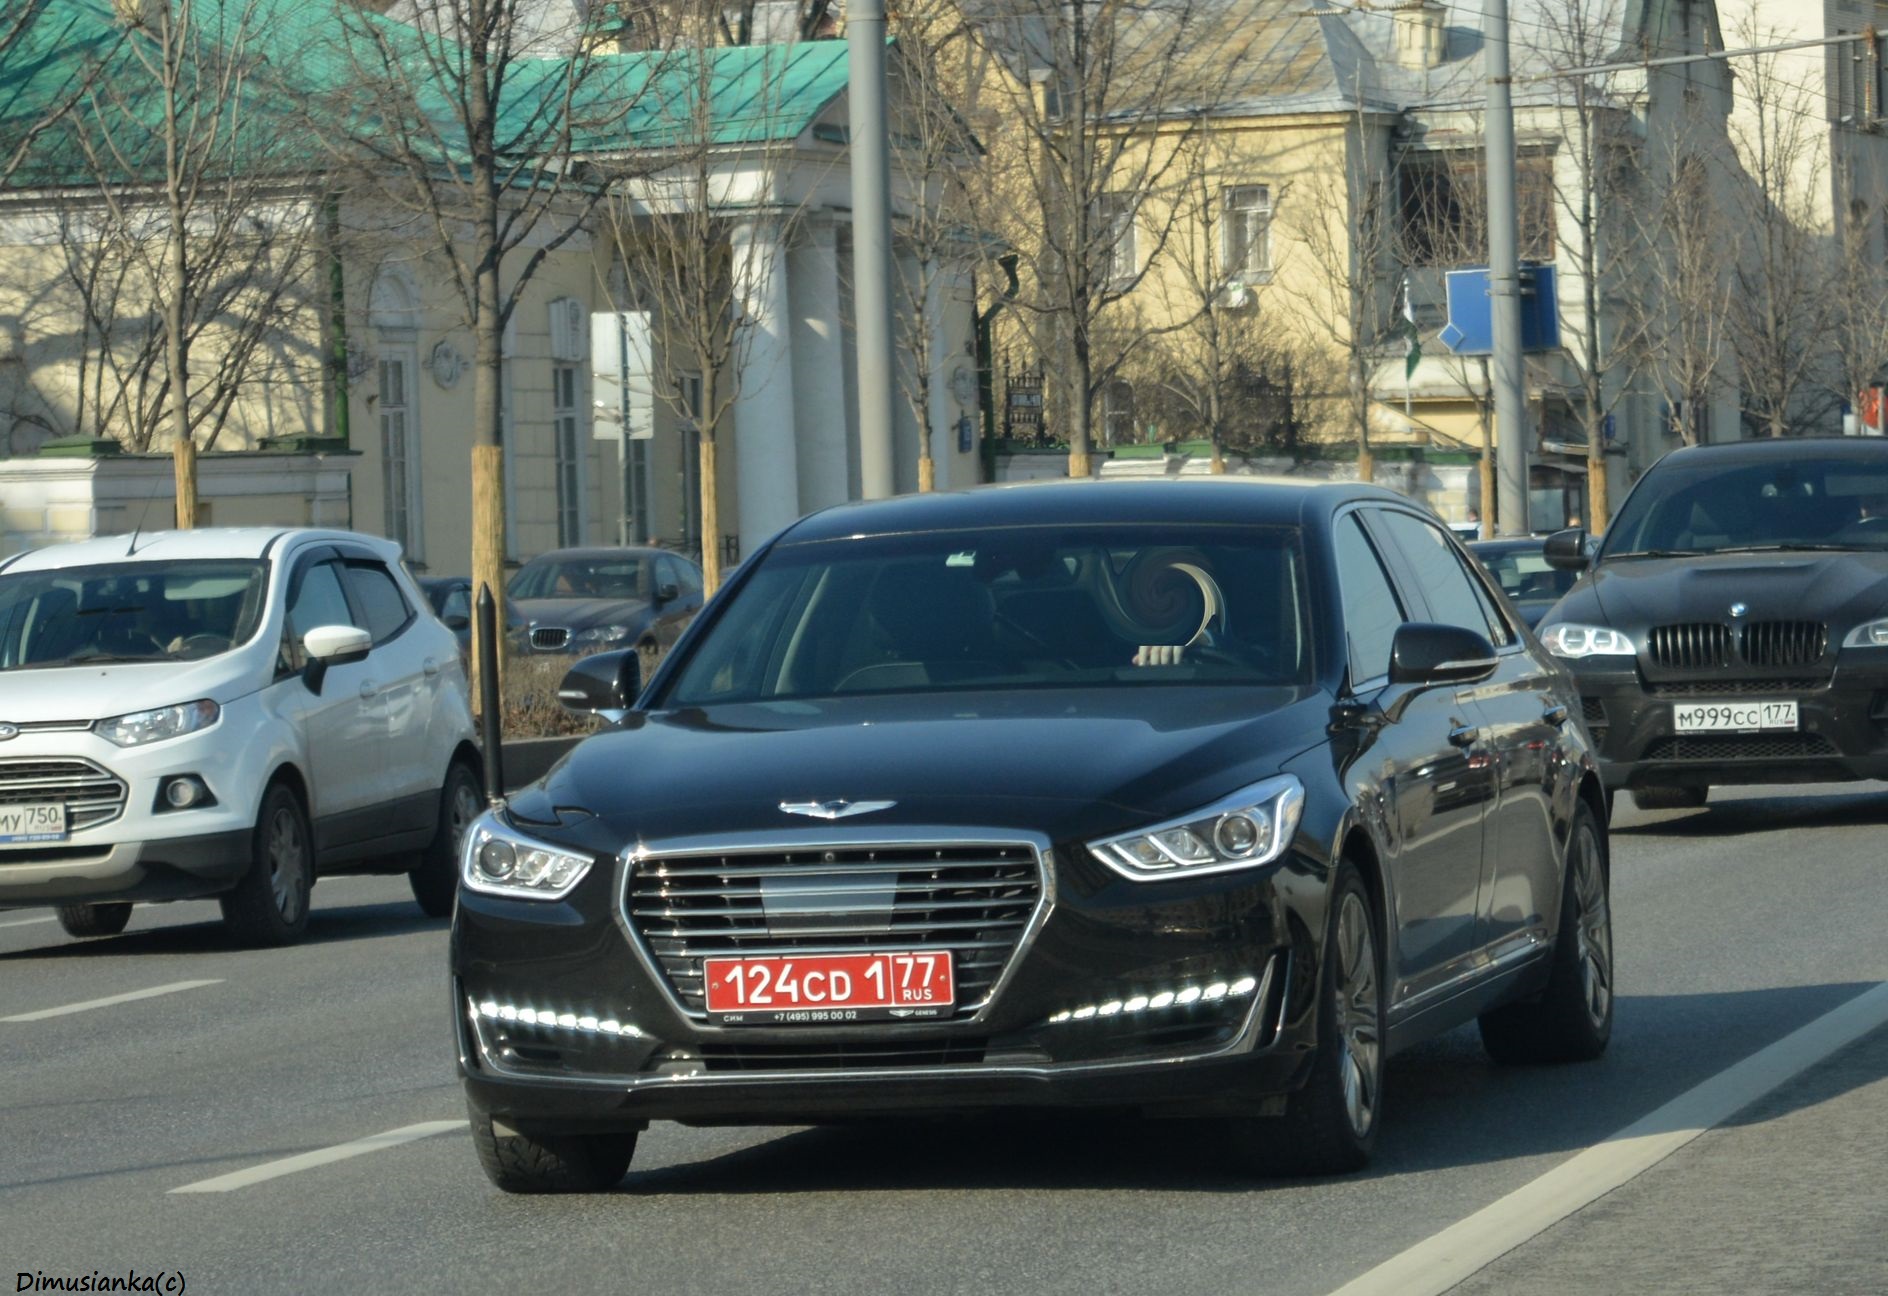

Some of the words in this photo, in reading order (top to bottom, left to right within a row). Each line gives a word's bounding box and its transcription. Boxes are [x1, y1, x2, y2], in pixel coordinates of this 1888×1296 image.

[1763, 704, 1791, 720] 177
[25, 807, 58, 824] 750
[896, 957, 935, 988] 77
[903, 989, 932, 1001] RUS
[774, 1013, 785, 1021] +7
[786, 1012, 809, 1021] (495)
[811, 1011, 829, 1021] 995
[830, 1011, 843, 1020] 00
[845, 1011, 857, 1020] 02
